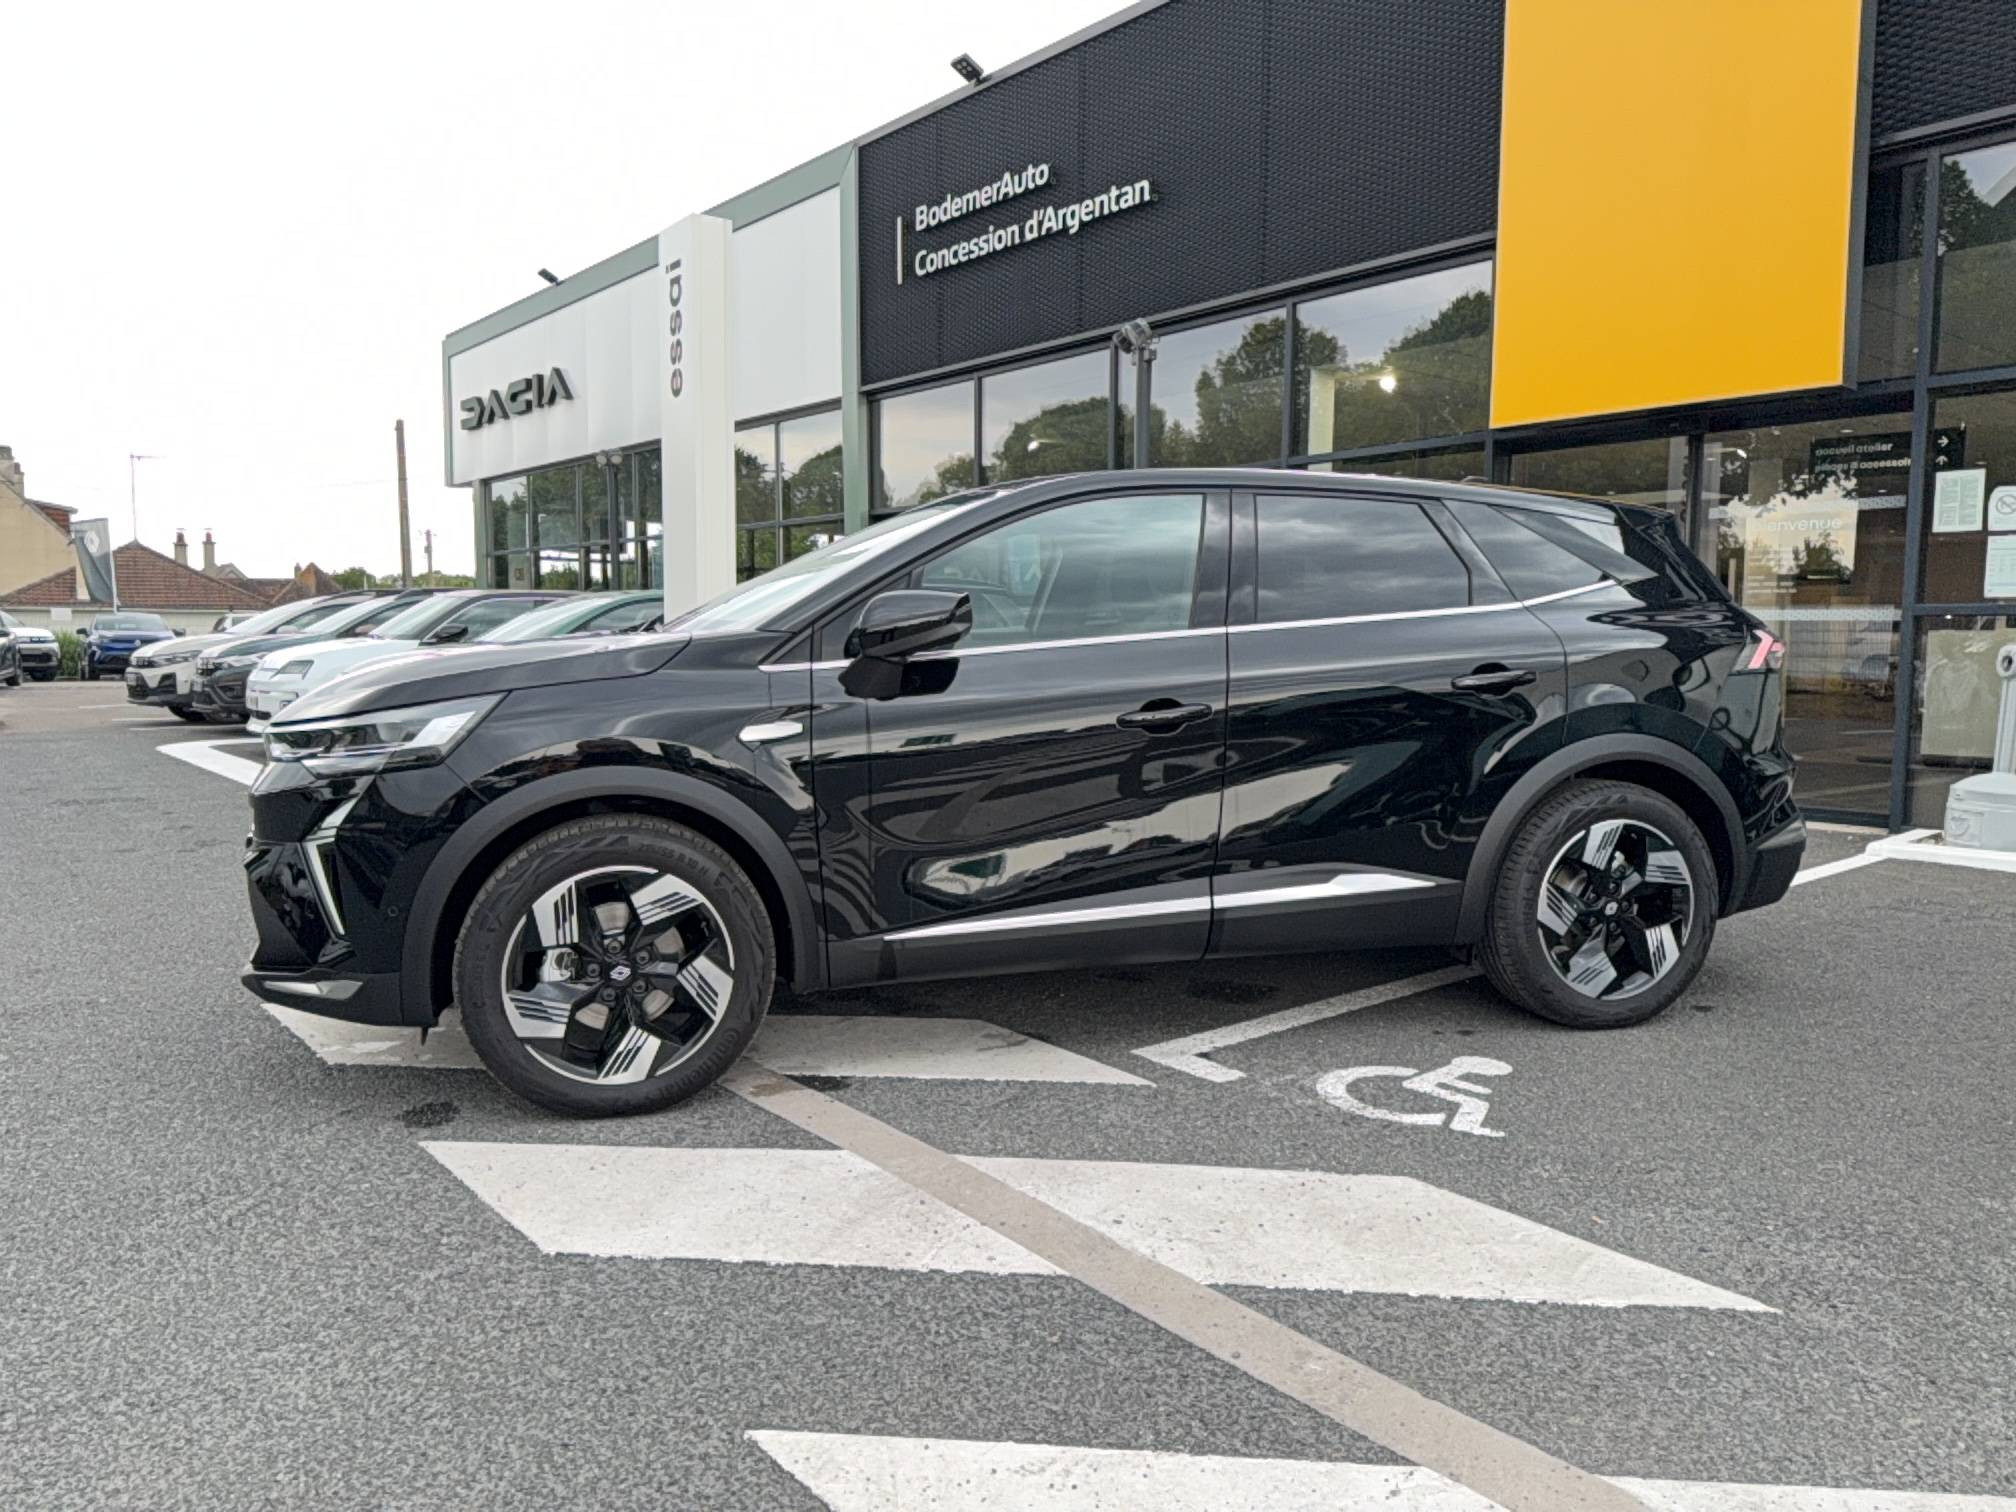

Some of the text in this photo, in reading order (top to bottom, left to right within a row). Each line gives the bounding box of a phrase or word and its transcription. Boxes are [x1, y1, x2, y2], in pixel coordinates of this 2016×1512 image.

[914, 179, 1151, 277] Concession d'Argentan
[915, 163, 1050, 232] BodemerAuto
[665, 258, 683, 398] essai
[460, 367, 574, 430] DACIA
[1860, 457, 1912, 470] accessoir
